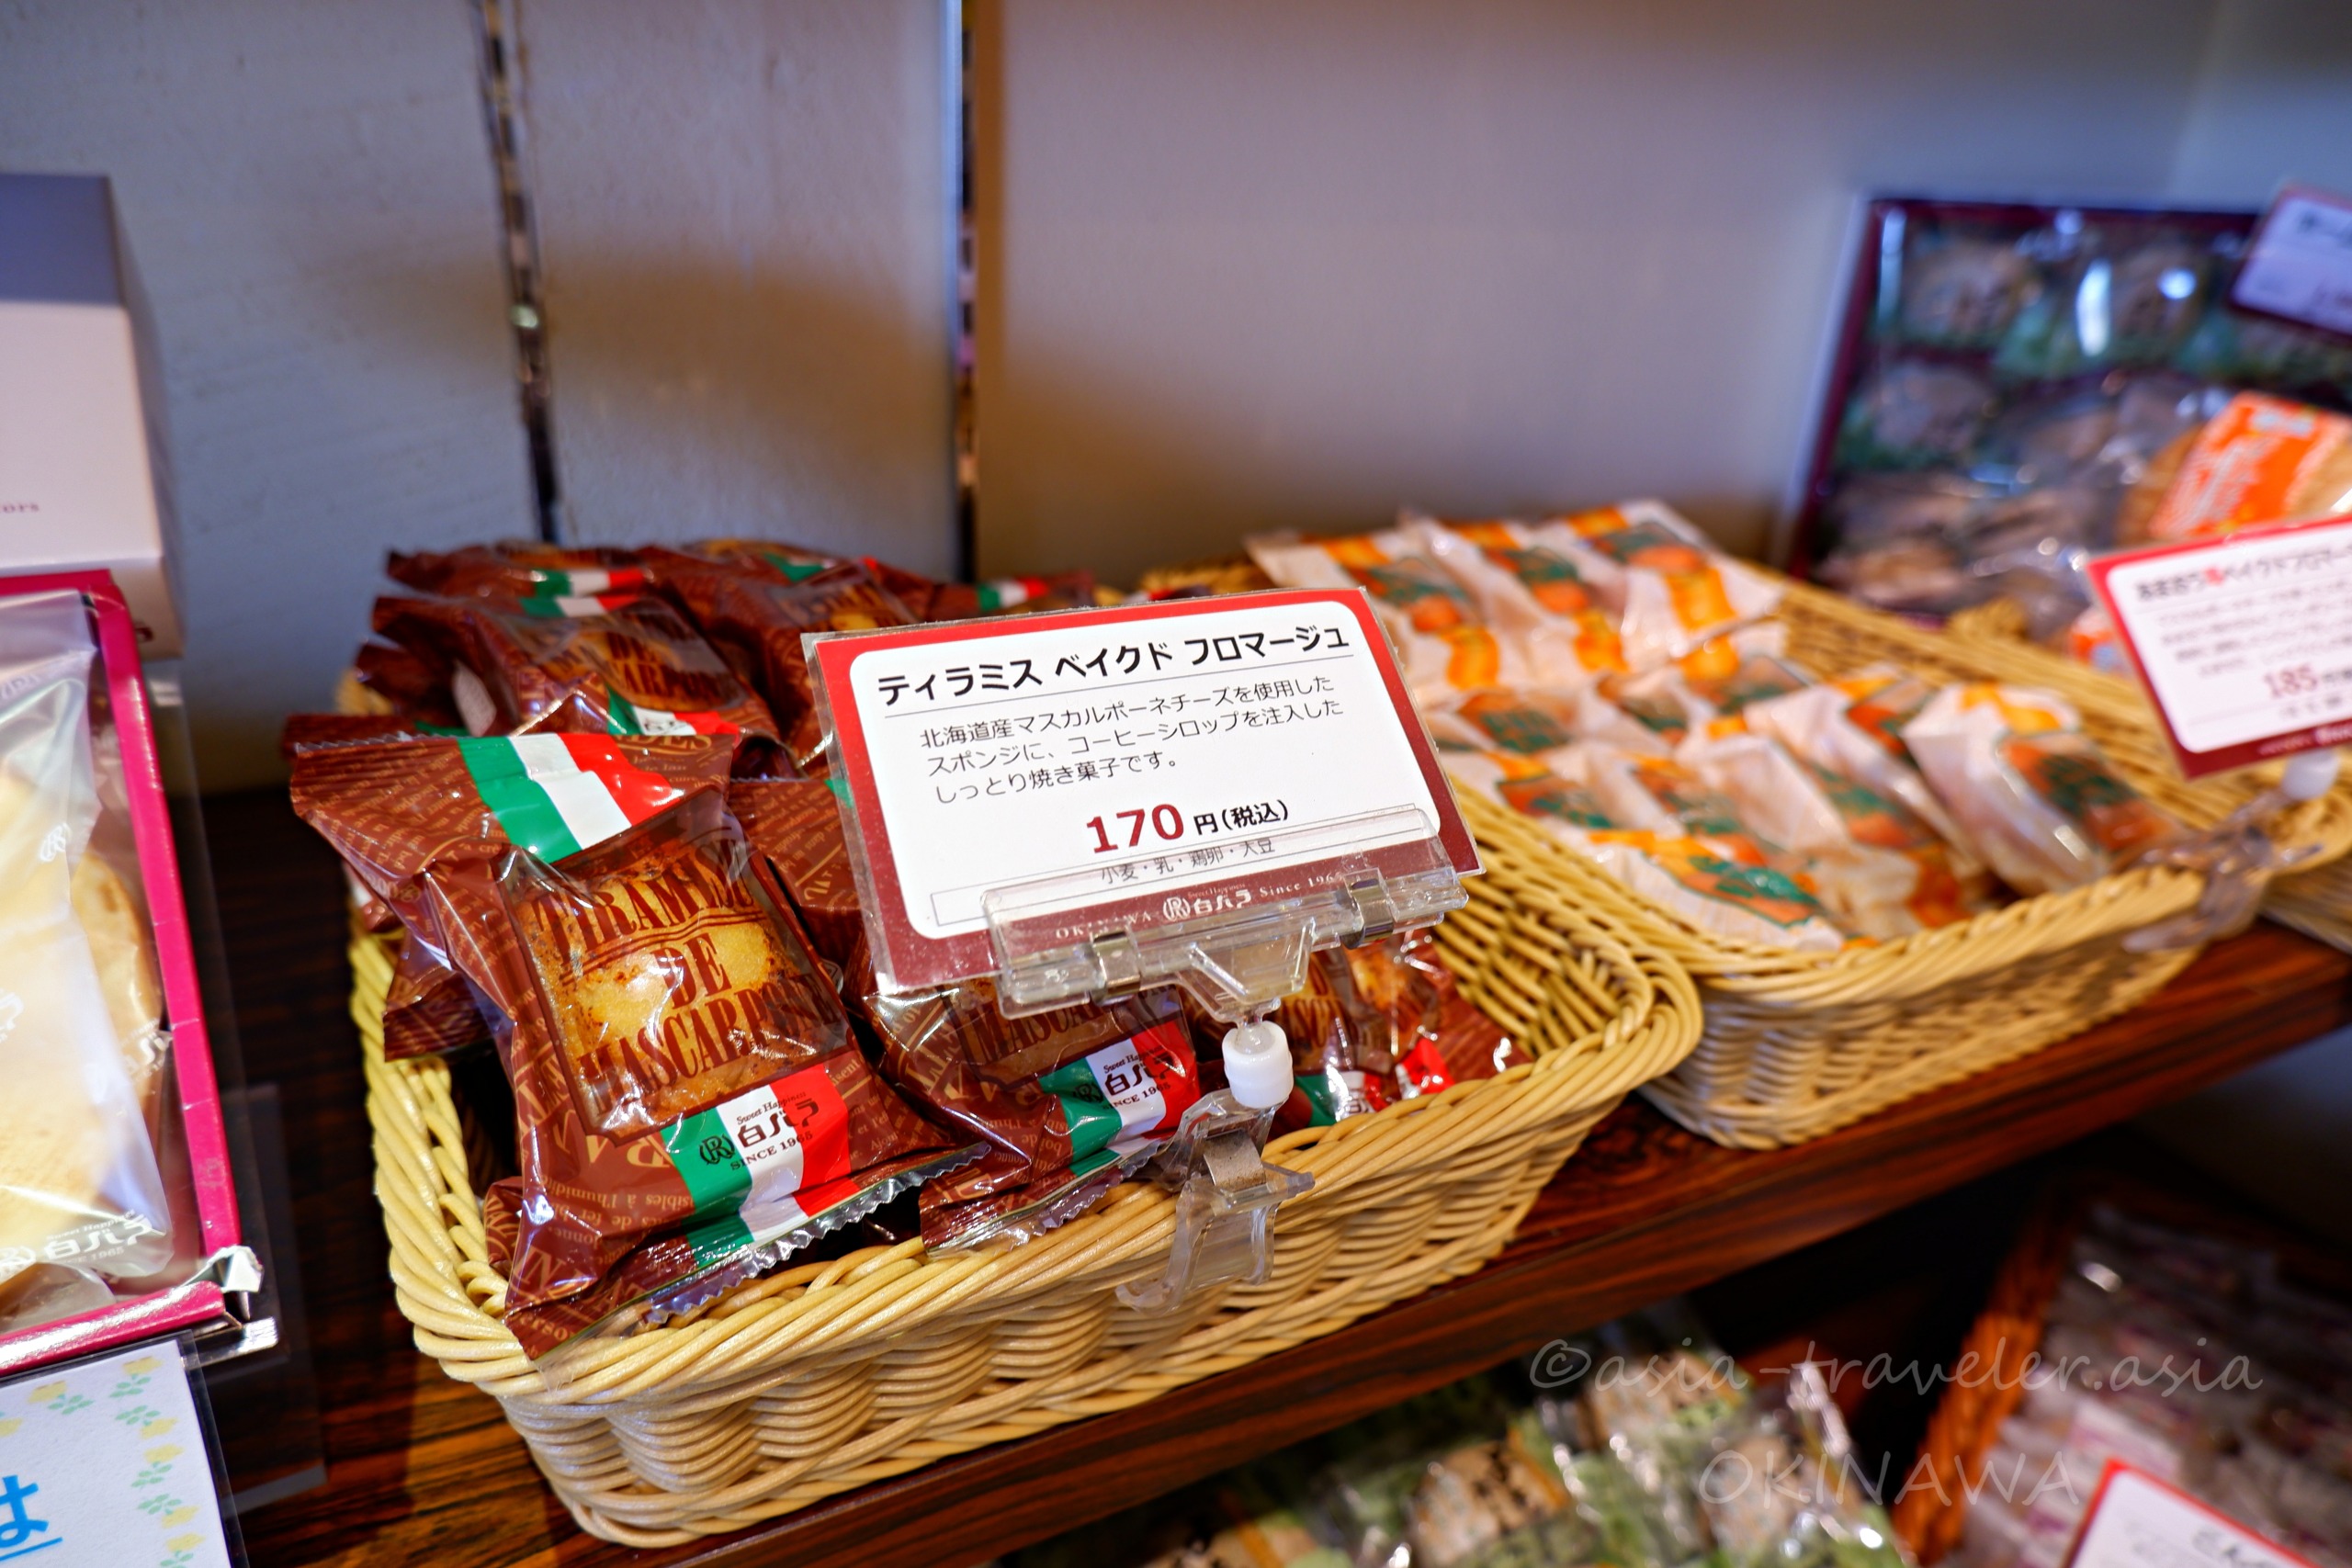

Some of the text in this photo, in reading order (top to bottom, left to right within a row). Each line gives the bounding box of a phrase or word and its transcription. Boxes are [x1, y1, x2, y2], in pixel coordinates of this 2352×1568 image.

[878, 626, 1350, 706] ティラミス ベイクド フロマージュ
[920, 676, 1335, 750] 北海道産マスカルポーネチーズを使用した
[927, 699, 1344, 777] スポンジに、コーヒーシロップを注入した
[936, 750, 1176, 804] しっとり焼き菓子です。
[1086, 803, 1184, 853] 170
[1259, 881, 1302, 898] Since
[650, 931, 732, 1010] DE
[736, 1106, 763, 1126] Sweet
[737, 1097, 820, 1149] 白バラ
[730, 1130, 814, 1171] SINCE 1965
